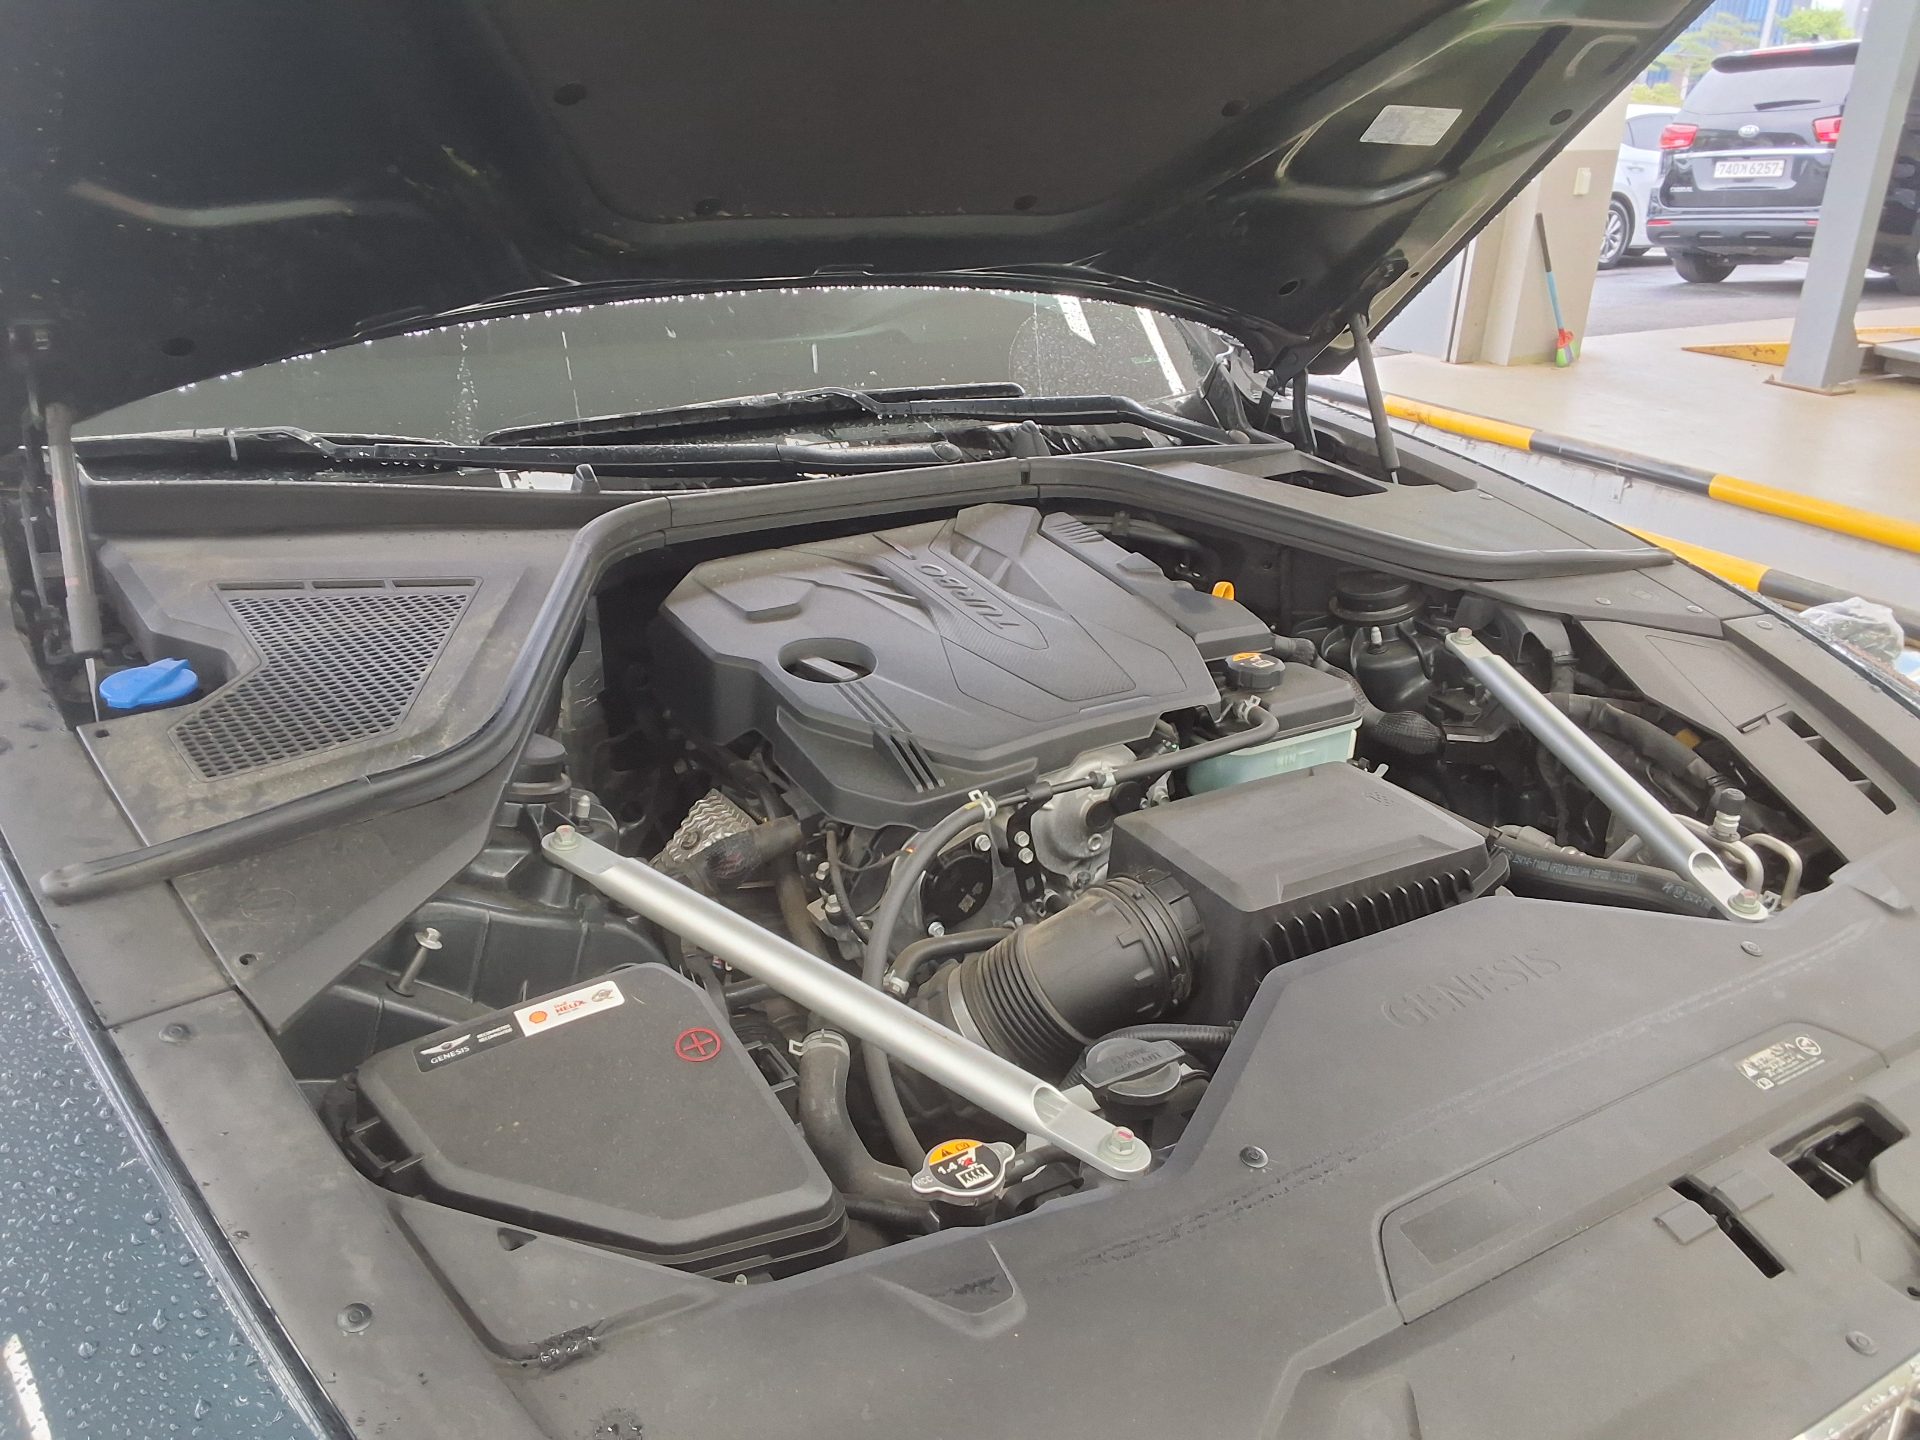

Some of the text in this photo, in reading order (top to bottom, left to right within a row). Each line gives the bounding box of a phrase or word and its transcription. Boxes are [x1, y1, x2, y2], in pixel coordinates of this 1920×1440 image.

[915, 563, 1020, 630] TURBO
[1380, 948, 1562, 1029] GENESIS
[430, 1045, 470, 1065] GENESIS
